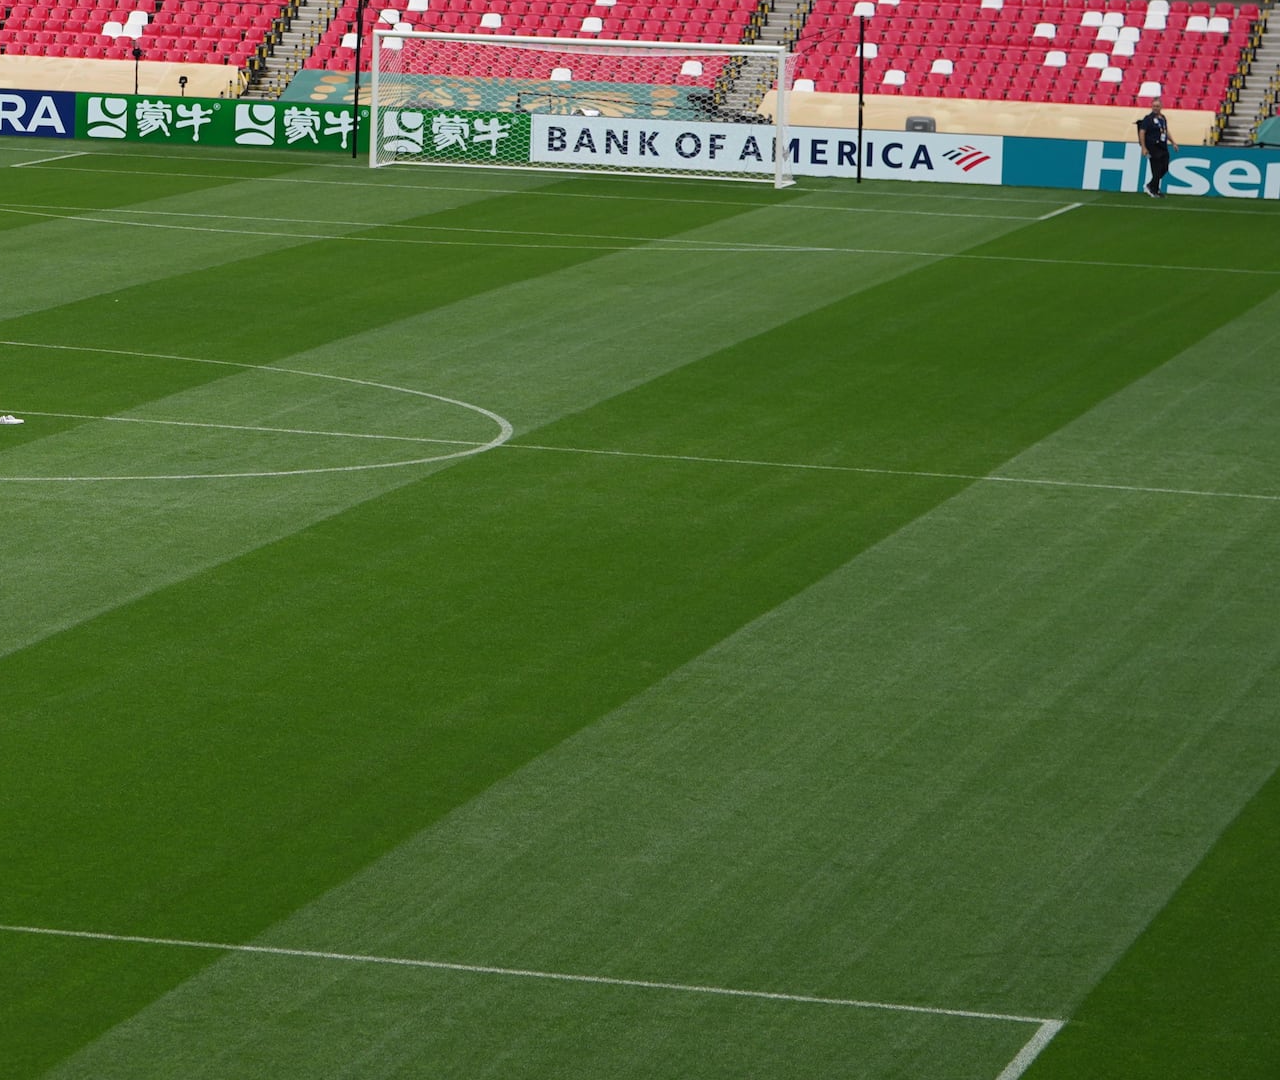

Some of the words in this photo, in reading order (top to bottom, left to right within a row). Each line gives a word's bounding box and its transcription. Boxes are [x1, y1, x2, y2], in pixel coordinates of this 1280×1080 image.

[135, 100, 212, 142] 蒙牛
[283, 107, 362, 149] 蒙牛
[547, 126, 659, 157] BANK
[675, 132, 727, 160] OF
[740, 134, 935, 170] AMERICA
